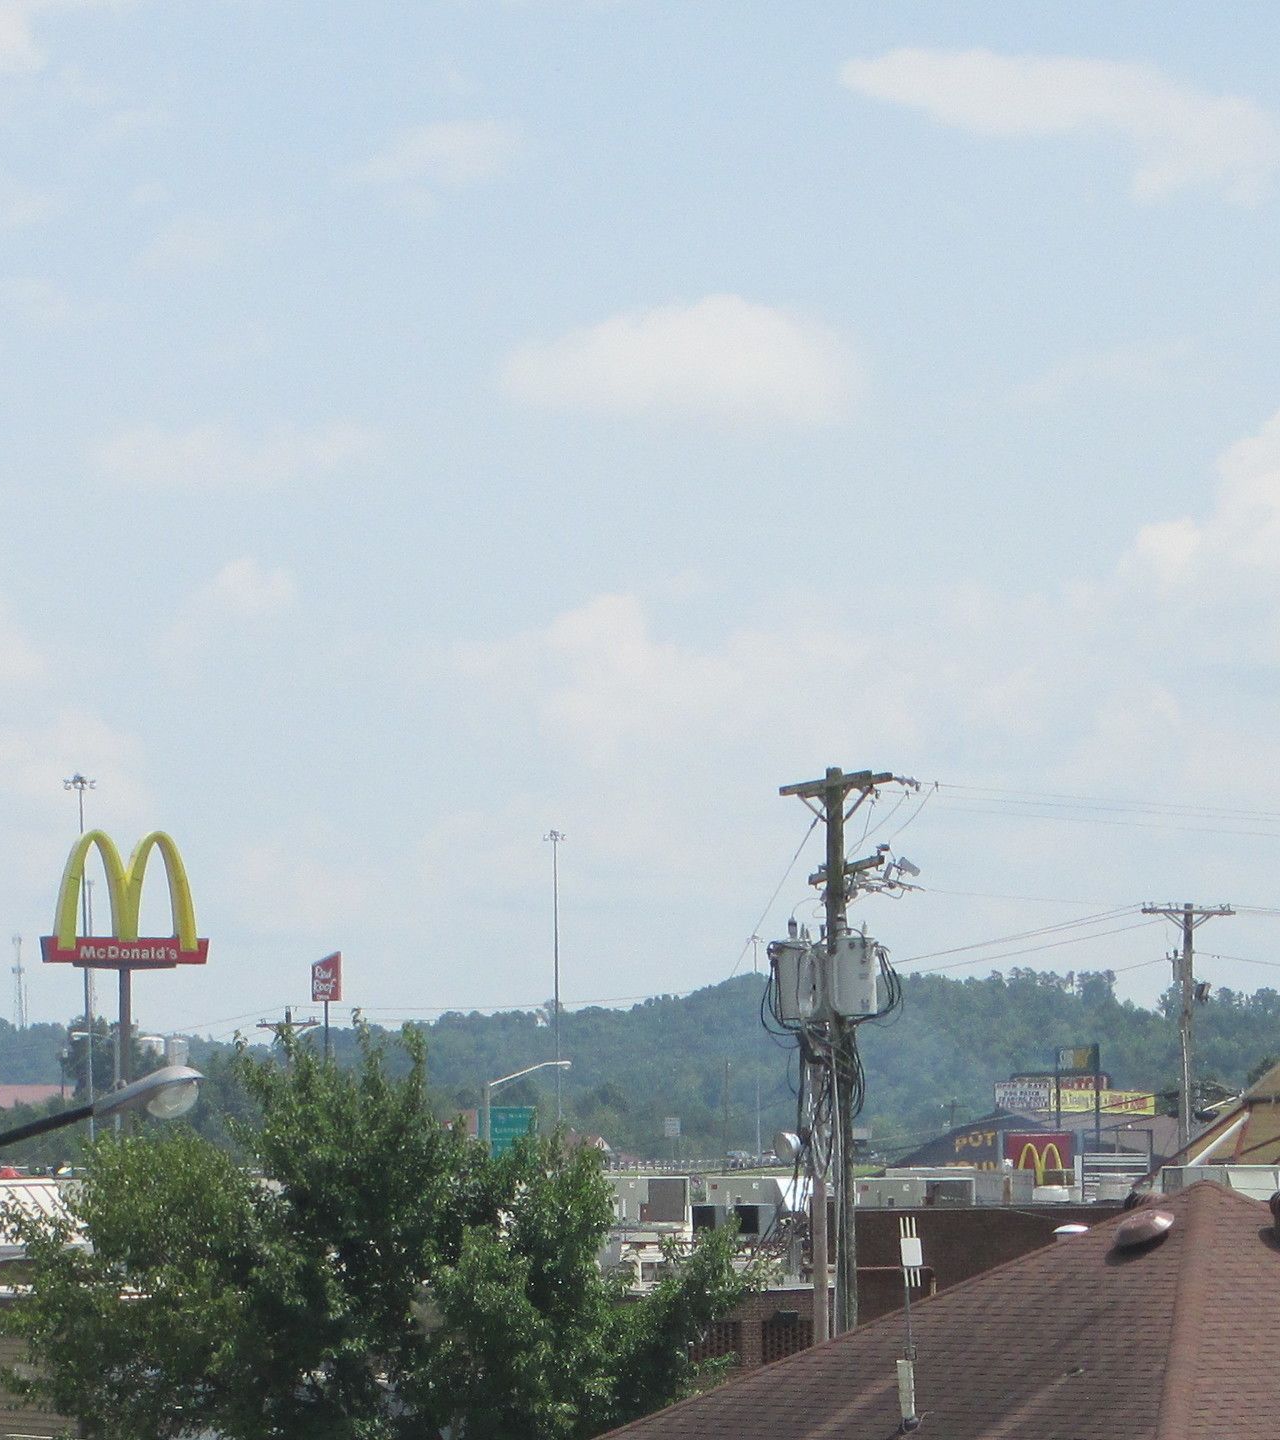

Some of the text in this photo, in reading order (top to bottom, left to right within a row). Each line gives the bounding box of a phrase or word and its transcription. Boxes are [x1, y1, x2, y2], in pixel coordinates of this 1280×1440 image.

[80, 945, 178, 960] McDonald's
[314, 965, 333, 979] Red
[312, 978, 337, 995] Roof
